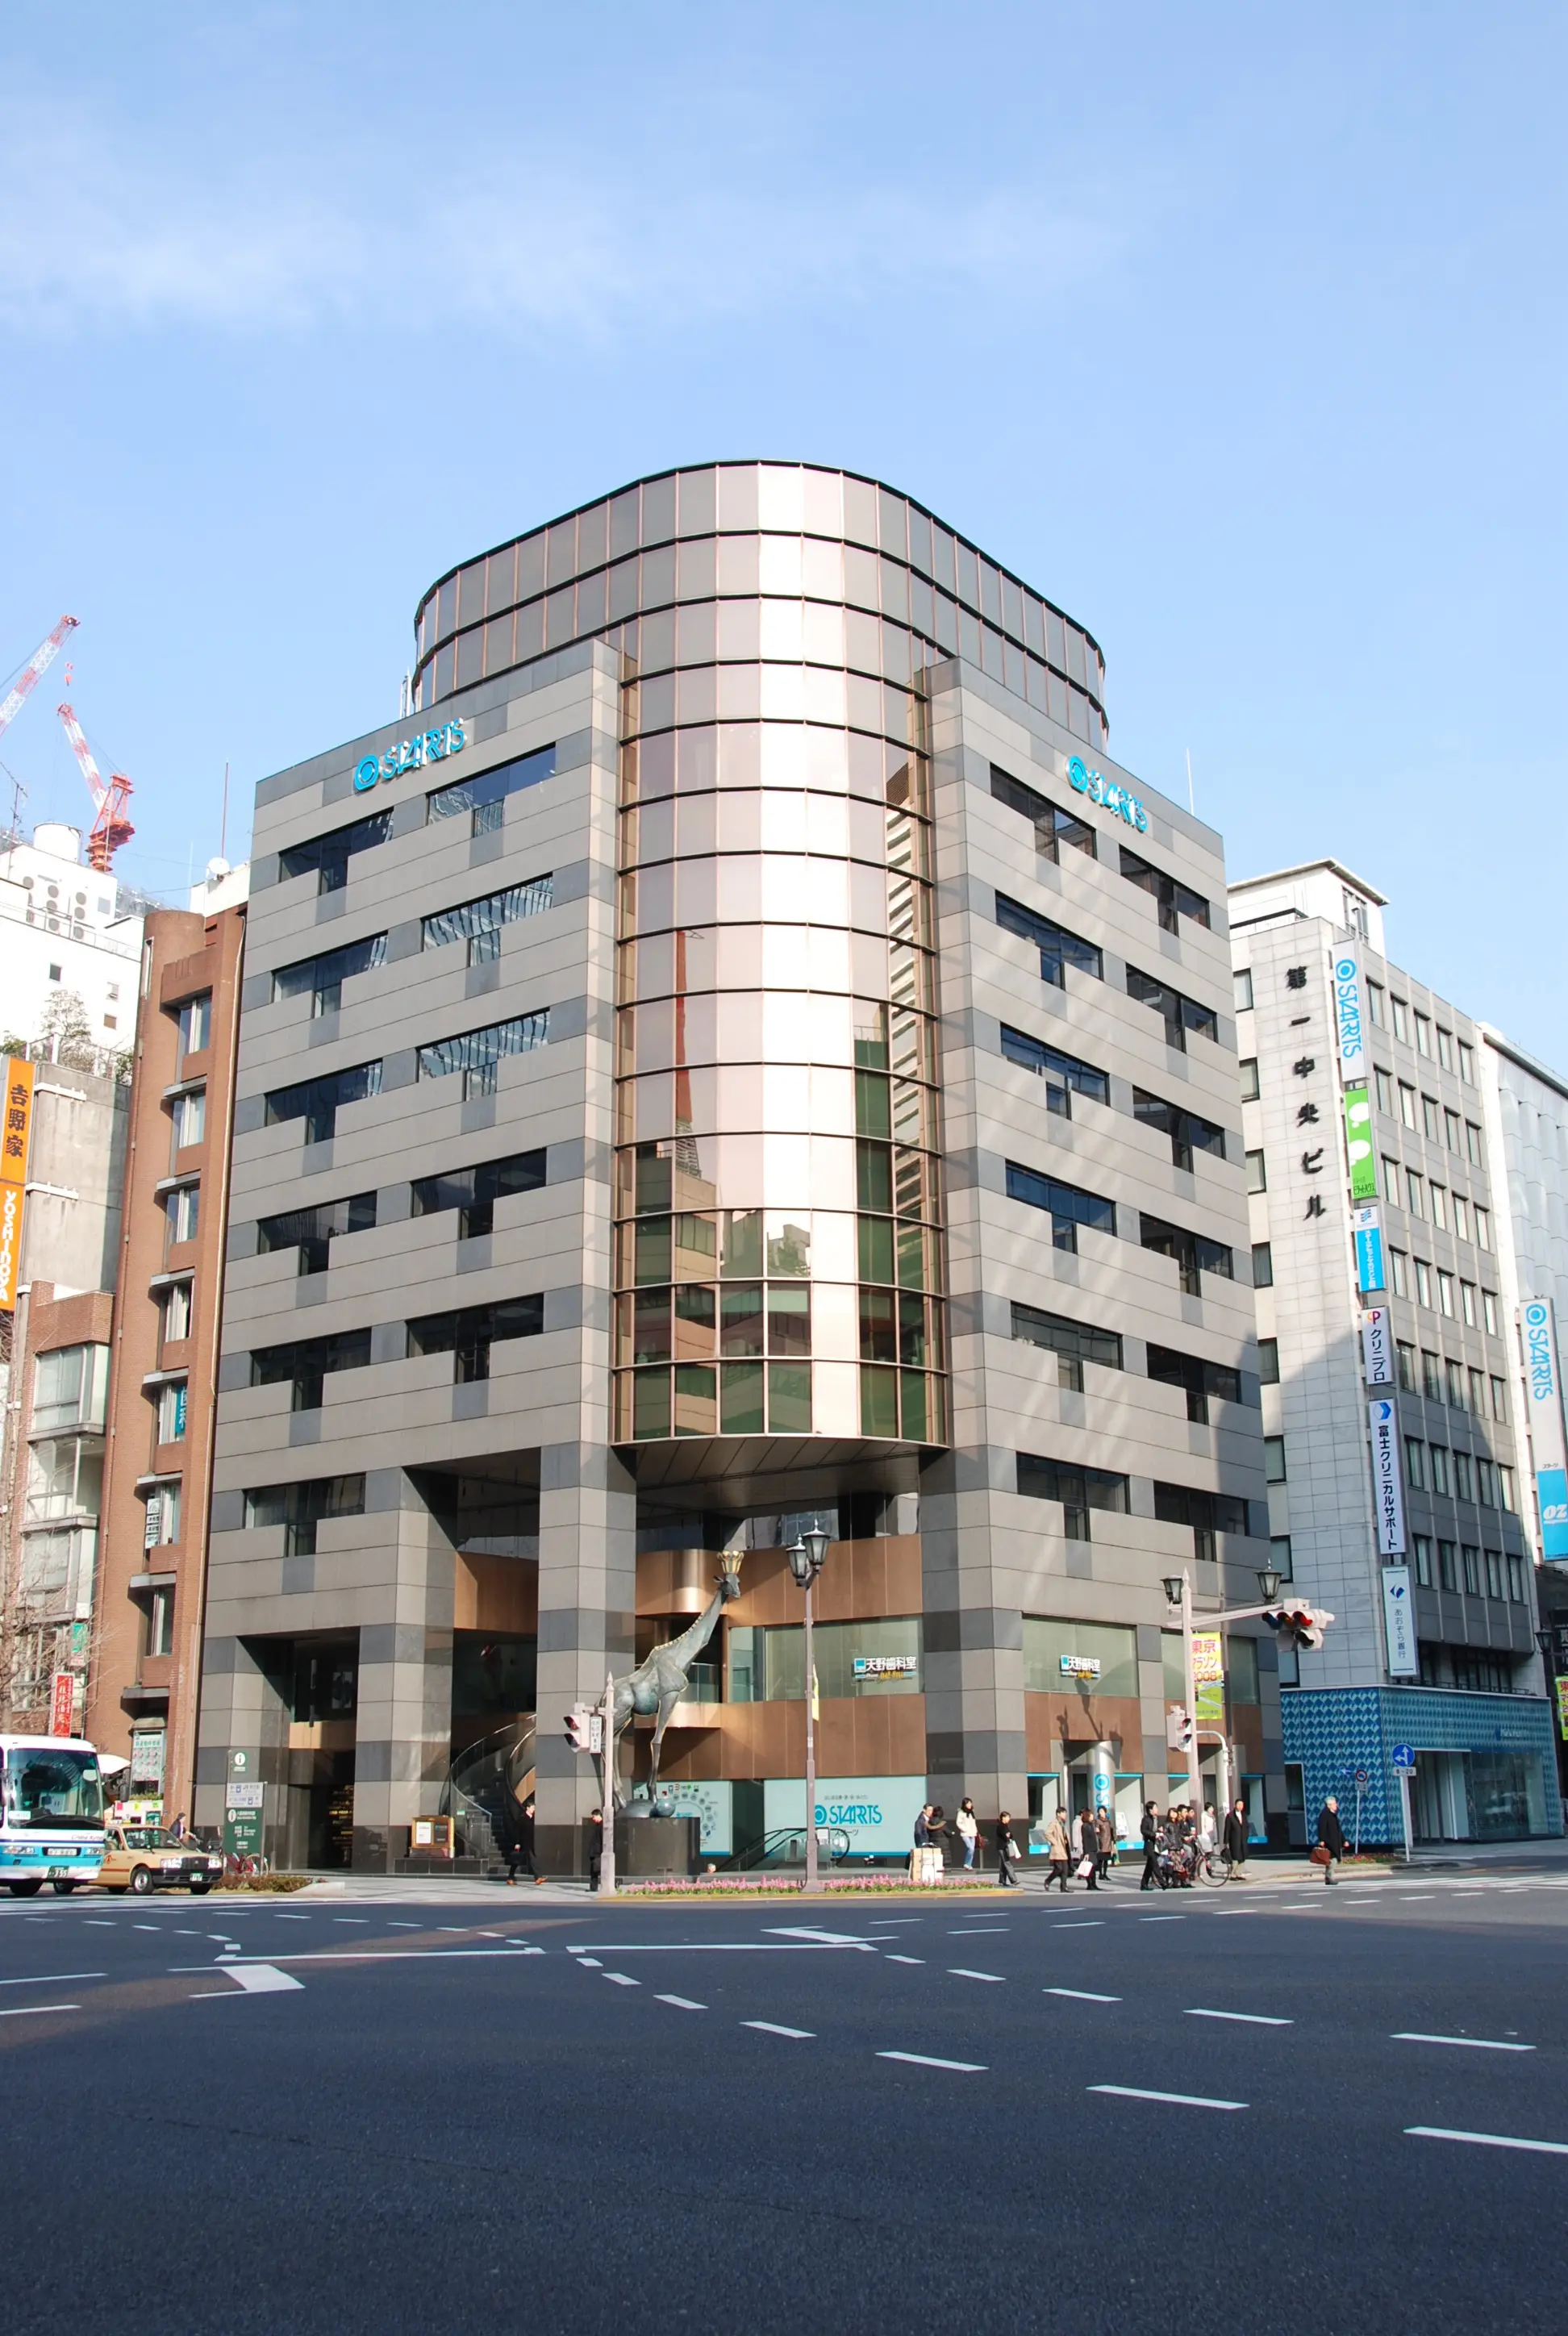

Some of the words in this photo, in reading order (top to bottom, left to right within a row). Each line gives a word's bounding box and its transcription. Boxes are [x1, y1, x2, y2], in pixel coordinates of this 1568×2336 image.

[1337, 984, 1362, 1058] STARTS
[6, 1083, 28, 1158] 吉野家
[1285, 966, 1327, 1221] 第一中央ビル
[1370, 1329, 1386, 1382] クリニプロ
[1528, 1329, 1553, 1400] STARTS
[1378, 1425, 1398, 1550] 富士クリニカルサポート
[1395, 1608, 1406, 1659] あおぞら銀行
[829, 1805, 882, 1825] STARTS
